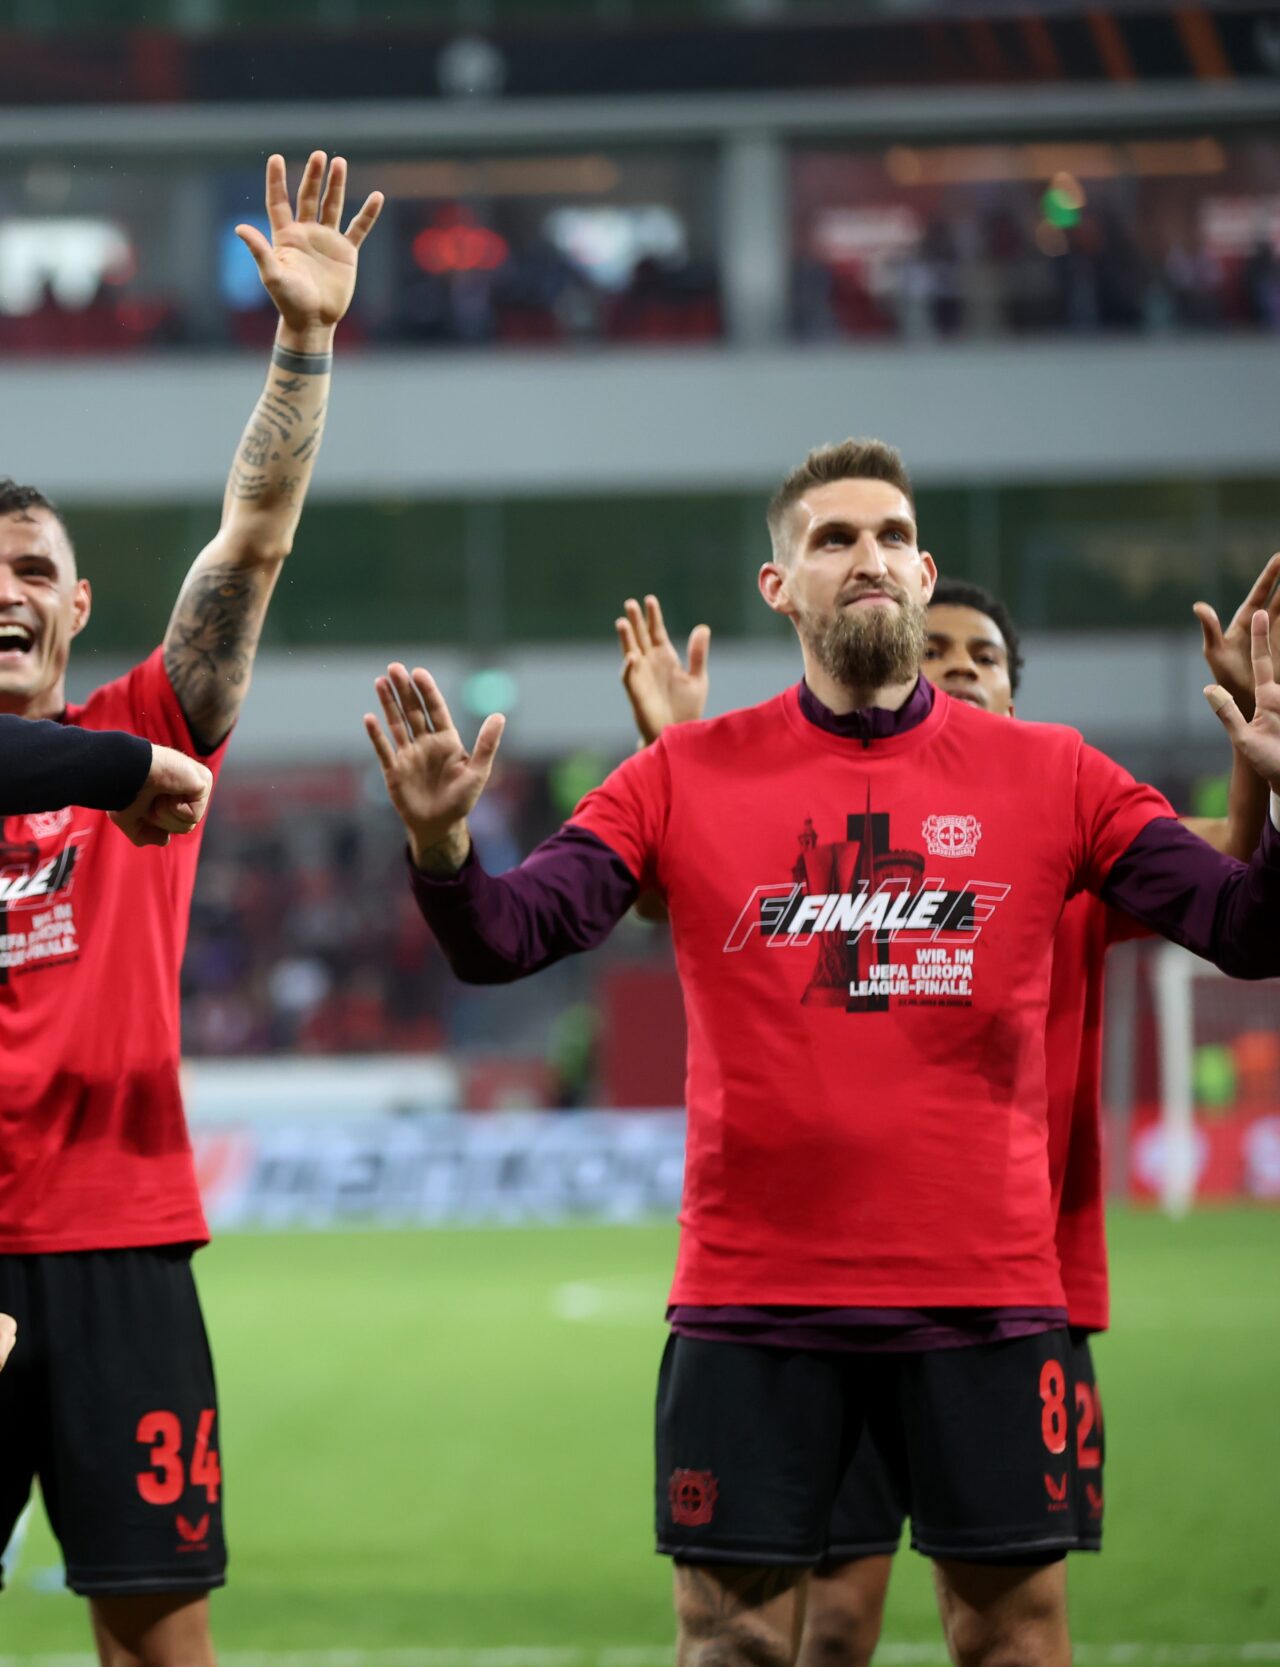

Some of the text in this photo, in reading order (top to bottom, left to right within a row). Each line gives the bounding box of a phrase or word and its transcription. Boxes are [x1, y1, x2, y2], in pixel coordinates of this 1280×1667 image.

[787, 890, 948, 933] FINALE
[869, 963, 973, 980] UEFA EUROPA
[916, 947, 974, 964] WIR. IM
[849, 979, 973, 997] LEAGUE-FINALE.
[1039, 1359, 1068, 1454] 8
[1074, 1380, 1105, 1470] 2
[136, 1408, 222, 1506] 34
